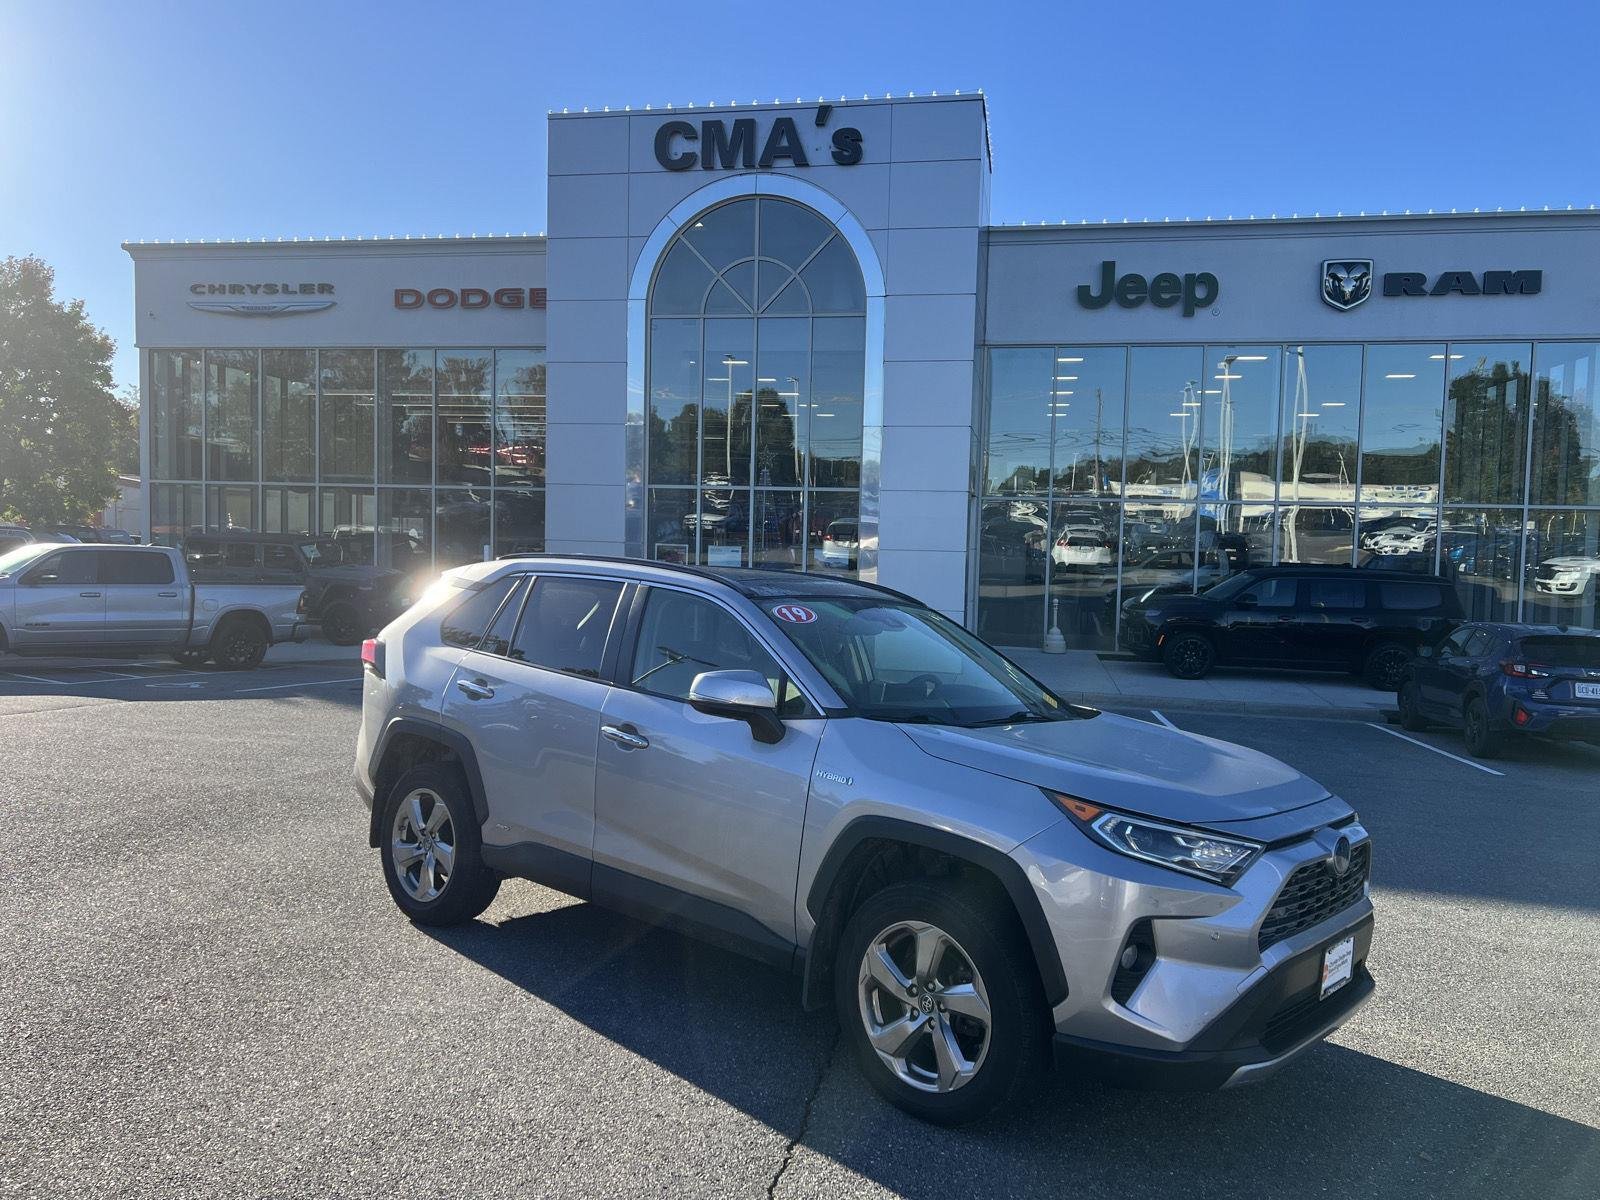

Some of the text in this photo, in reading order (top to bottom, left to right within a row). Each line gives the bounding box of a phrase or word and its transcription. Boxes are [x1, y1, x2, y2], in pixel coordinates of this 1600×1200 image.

[654, 105, 863, 170] CMA's
[190, 283, 335, 295] CHRYSLER
[1077, 261, 1219, 317] Jeep
[1383, 270, 1543, 296] RAM
[780, 606, 807, 622] 19
[816, 769, 847, 784] HYBRID
